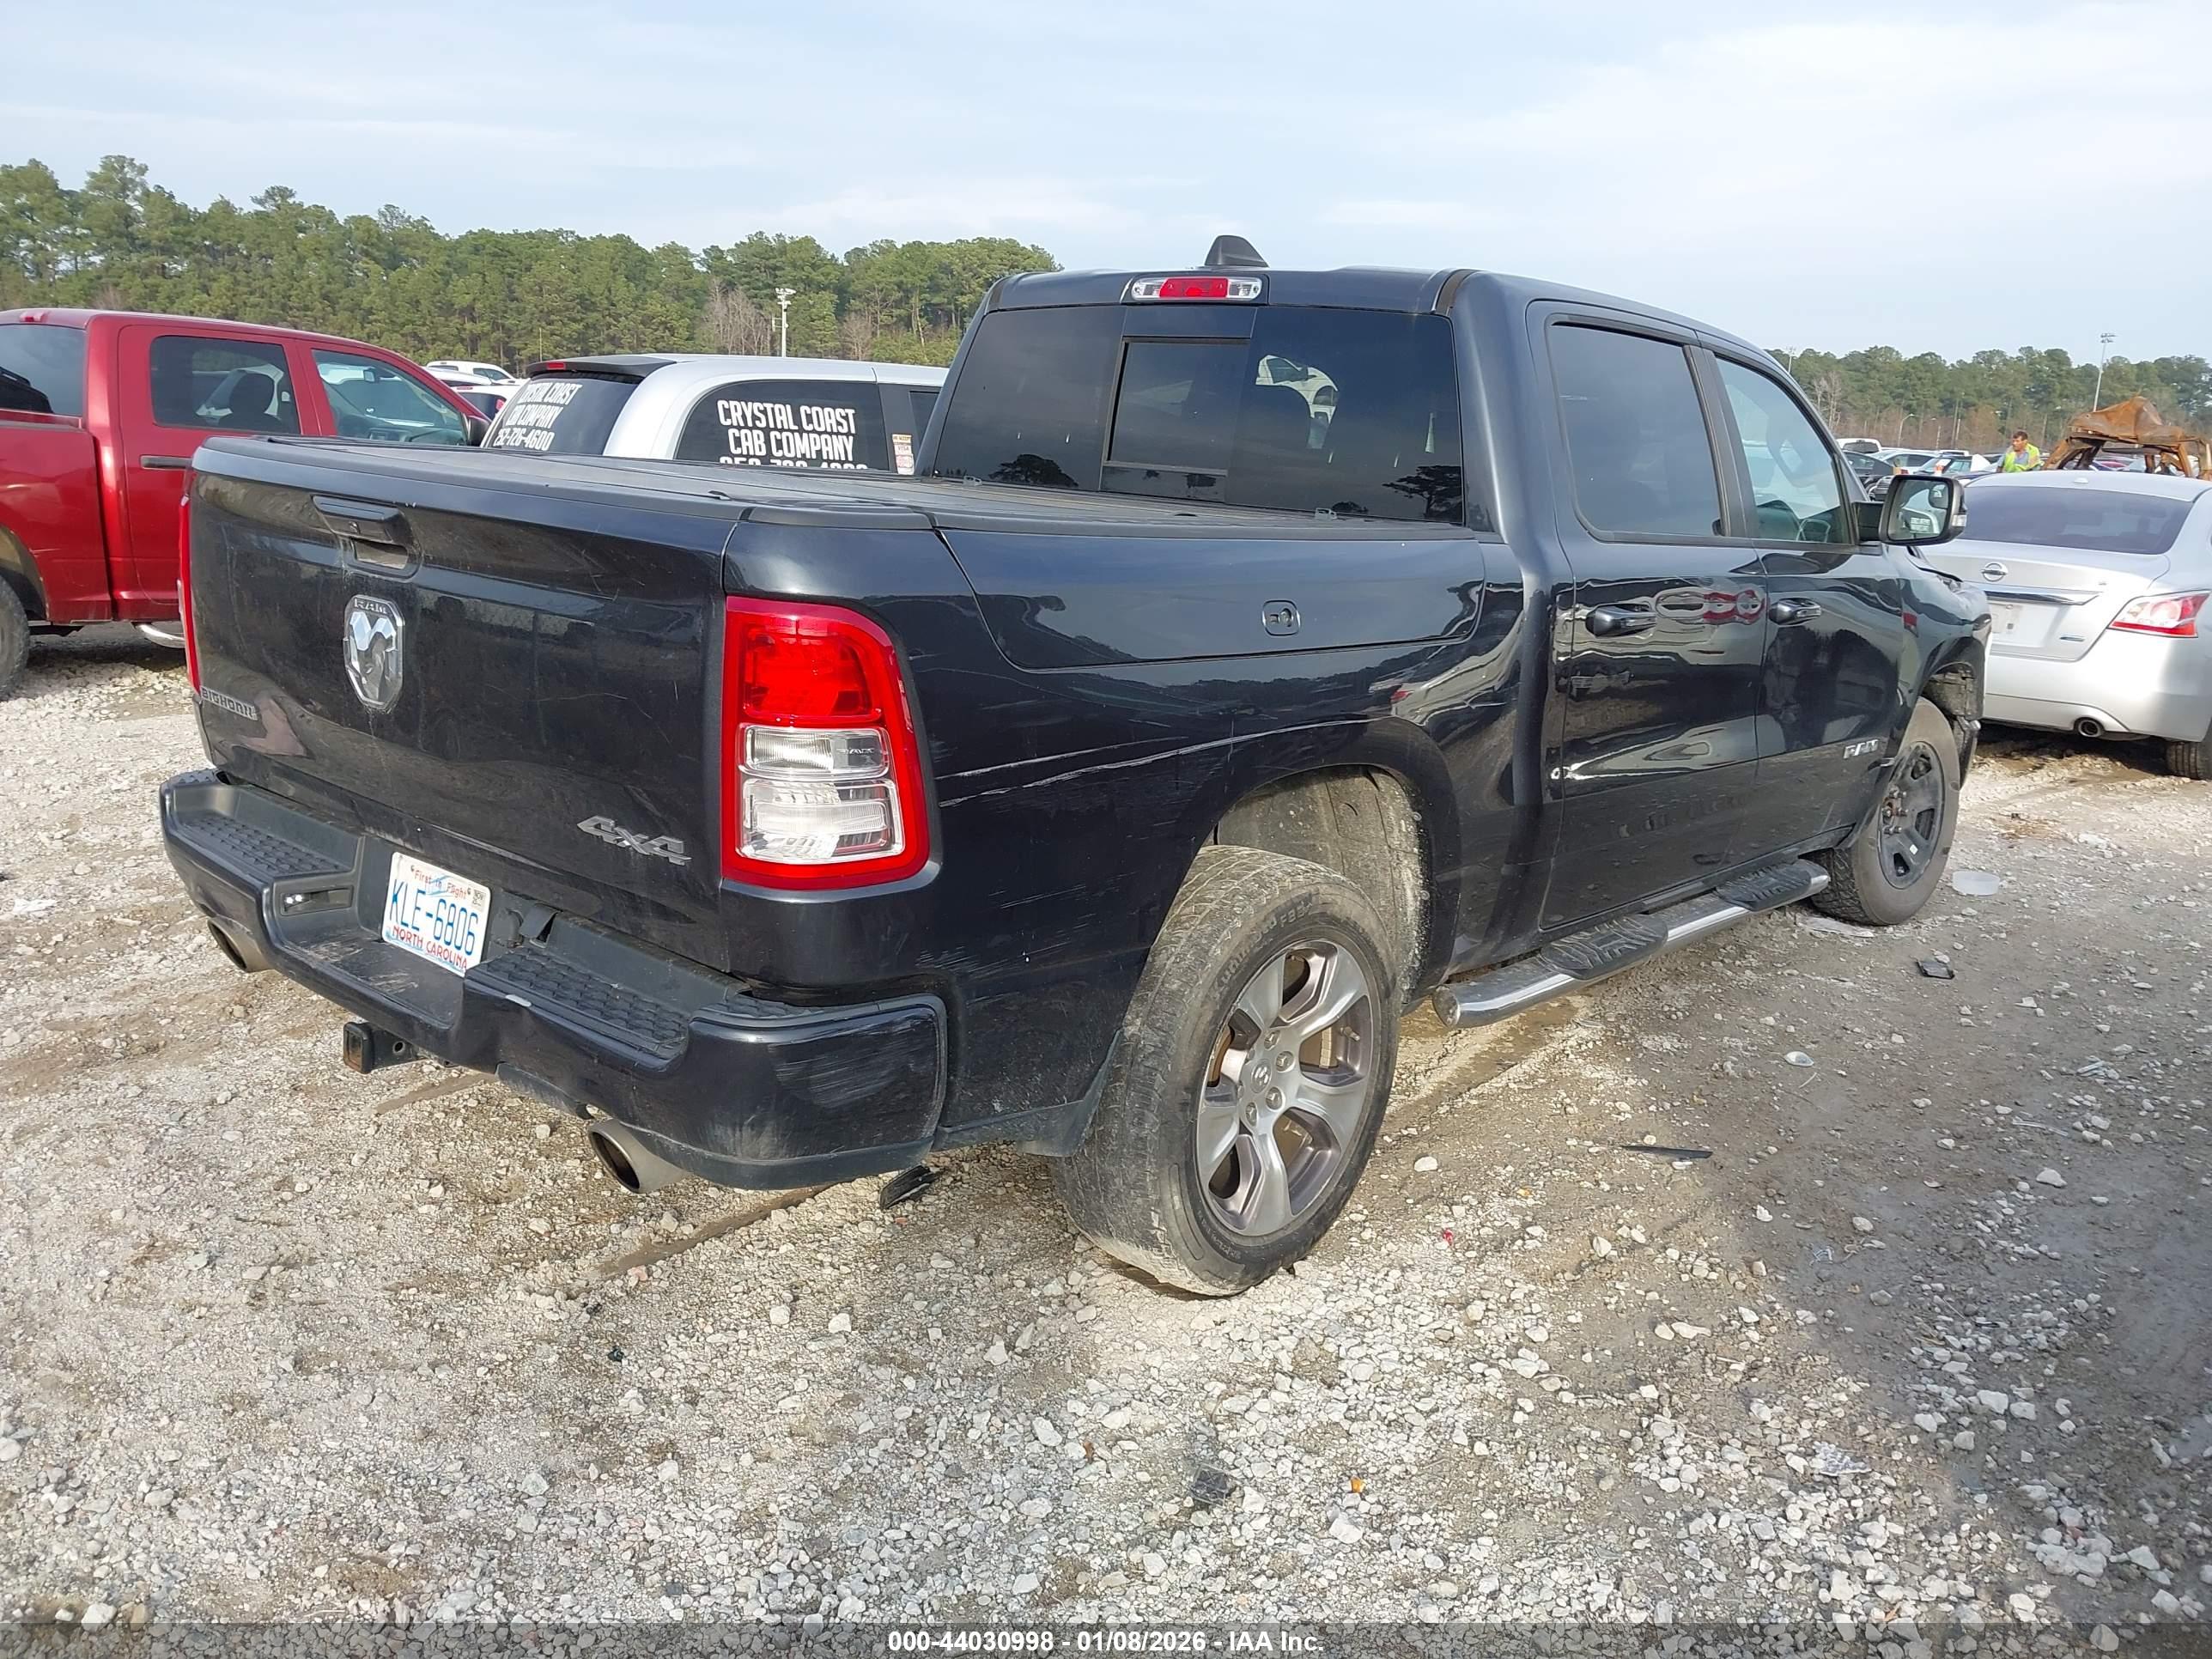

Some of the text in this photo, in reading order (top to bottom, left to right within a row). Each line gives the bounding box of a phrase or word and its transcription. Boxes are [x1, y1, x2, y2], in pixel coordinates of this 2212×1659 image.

[543, 382, 583, 405] COAST
[516, 404, 564, 428] COMPANY
[717, 399, 857, 434] CRYSTAL COAST
[727, 428, 854, 462] CAB COMPANY
[354, 598, 387, 614] RAM
[201, 687, 257, 720] BIGHORN
[1843, 738, 1879, 759] RAM
[414, 869, 432, 885] First
[447, 882, 467, 900] Flight
[390, 878, 478, 957] KLE-6806
[392, 926, 468, 969] NORTH CAROLINA
